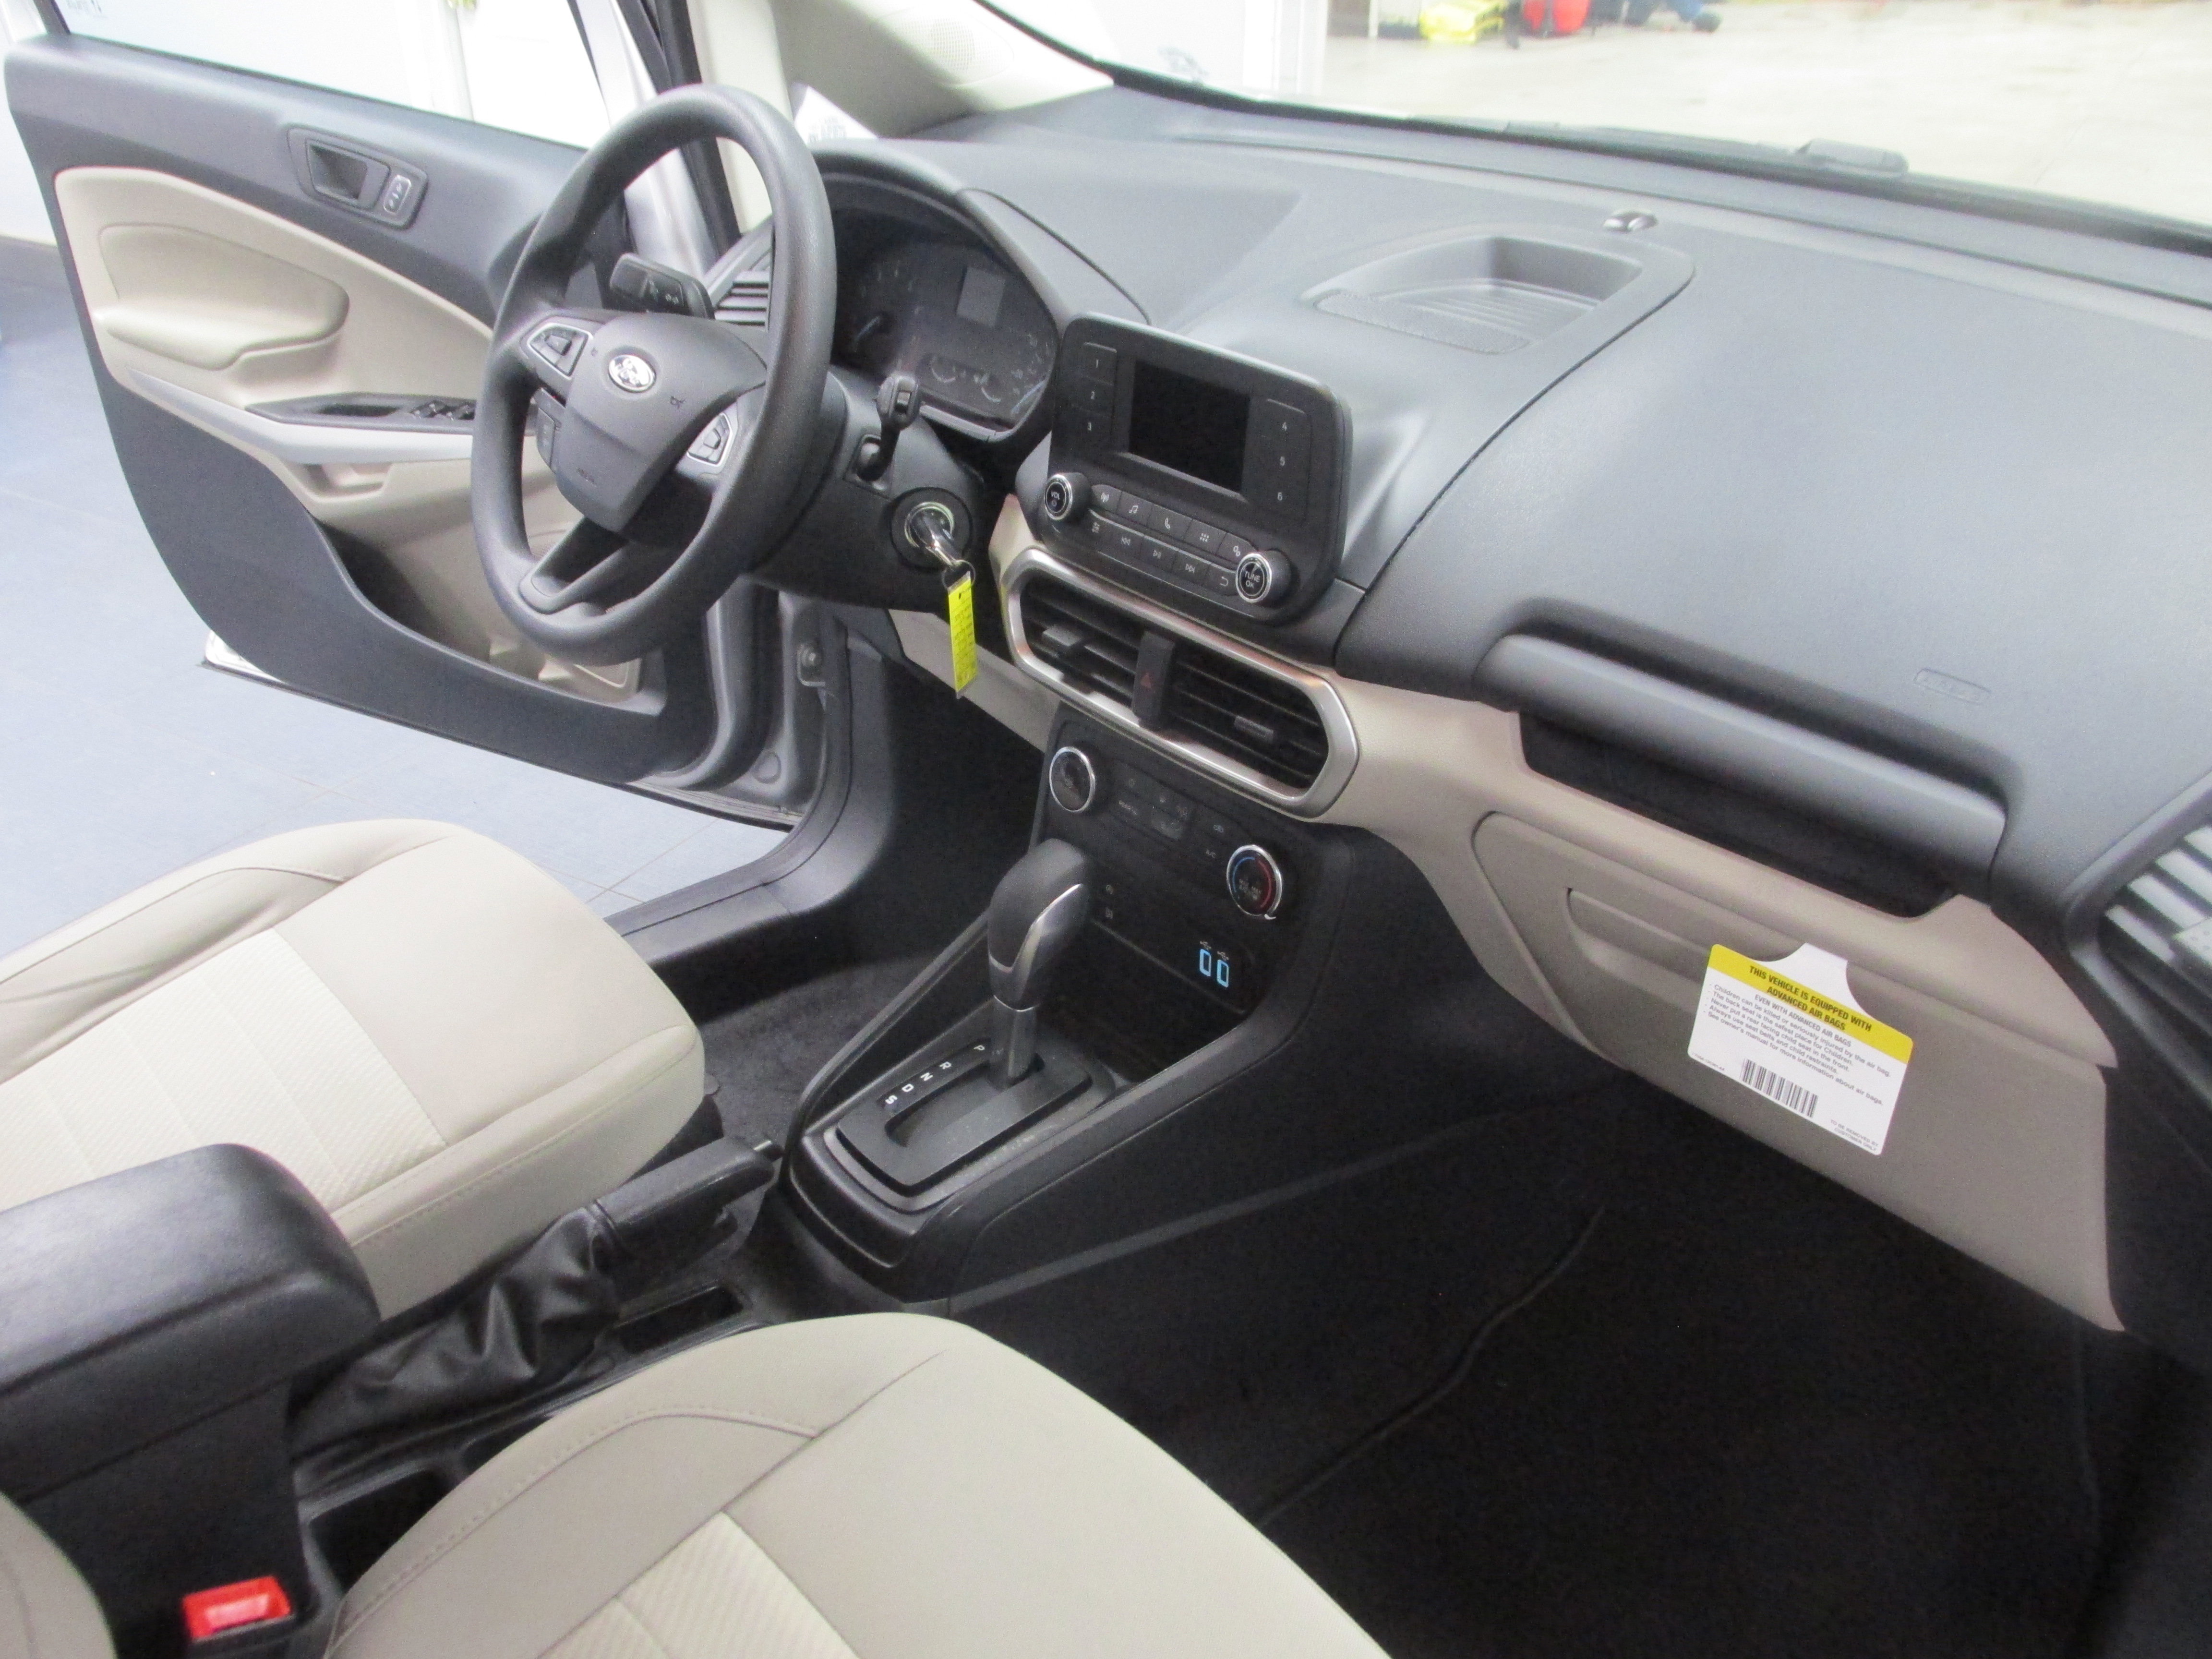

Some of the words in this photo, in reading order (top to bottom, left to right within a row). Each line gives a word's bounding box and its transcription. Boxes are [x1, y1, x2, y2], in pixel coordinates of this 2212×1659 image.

[1096, 360, 1099, 368] 1
[1091, 391, 1095, 400] 2
[1087, 422, 1092, 431] 3
[1282, 421, 1287, 431] 4
[1280, 456, 1285, 466] 5
[1051, 490, 1060, 500] VOL
[1277, 492, 1283, 501] 6
[1244, 570, 1261, 582] TUNE
[1246, 580, 1254, 589] OK
[1749, 966, 1767, 979] THIS
[1768, 975, 1799, 995] VEHICLE
[1801, 991, 1808, 999] IS
[1810, 995, 1849, 1019] EQUIPPED
[1850, 1015, 1872, 1030] WITH
[1767, 986, 1807, 1010] ADVANCED
[1809, 1007, 1822, 1018] AIR
[1824, 1014, 1846, 1030] BAGS
[1755, 994, 1770, 1006] EVEN
[1771, 1002, 1787, 1014] WITH
[1789, 1011, 1821, 1031] ADVANCED
[1822, 1027, 1833, 1037] AIR
[1834, 1034, 1851, 1046] BAGS
[939, 1061, 952, 1070] R
[920, 1072, 933, 1081] N
[902, 1083, 914, 1092] D
[885, 1095, 898, 1104] S
